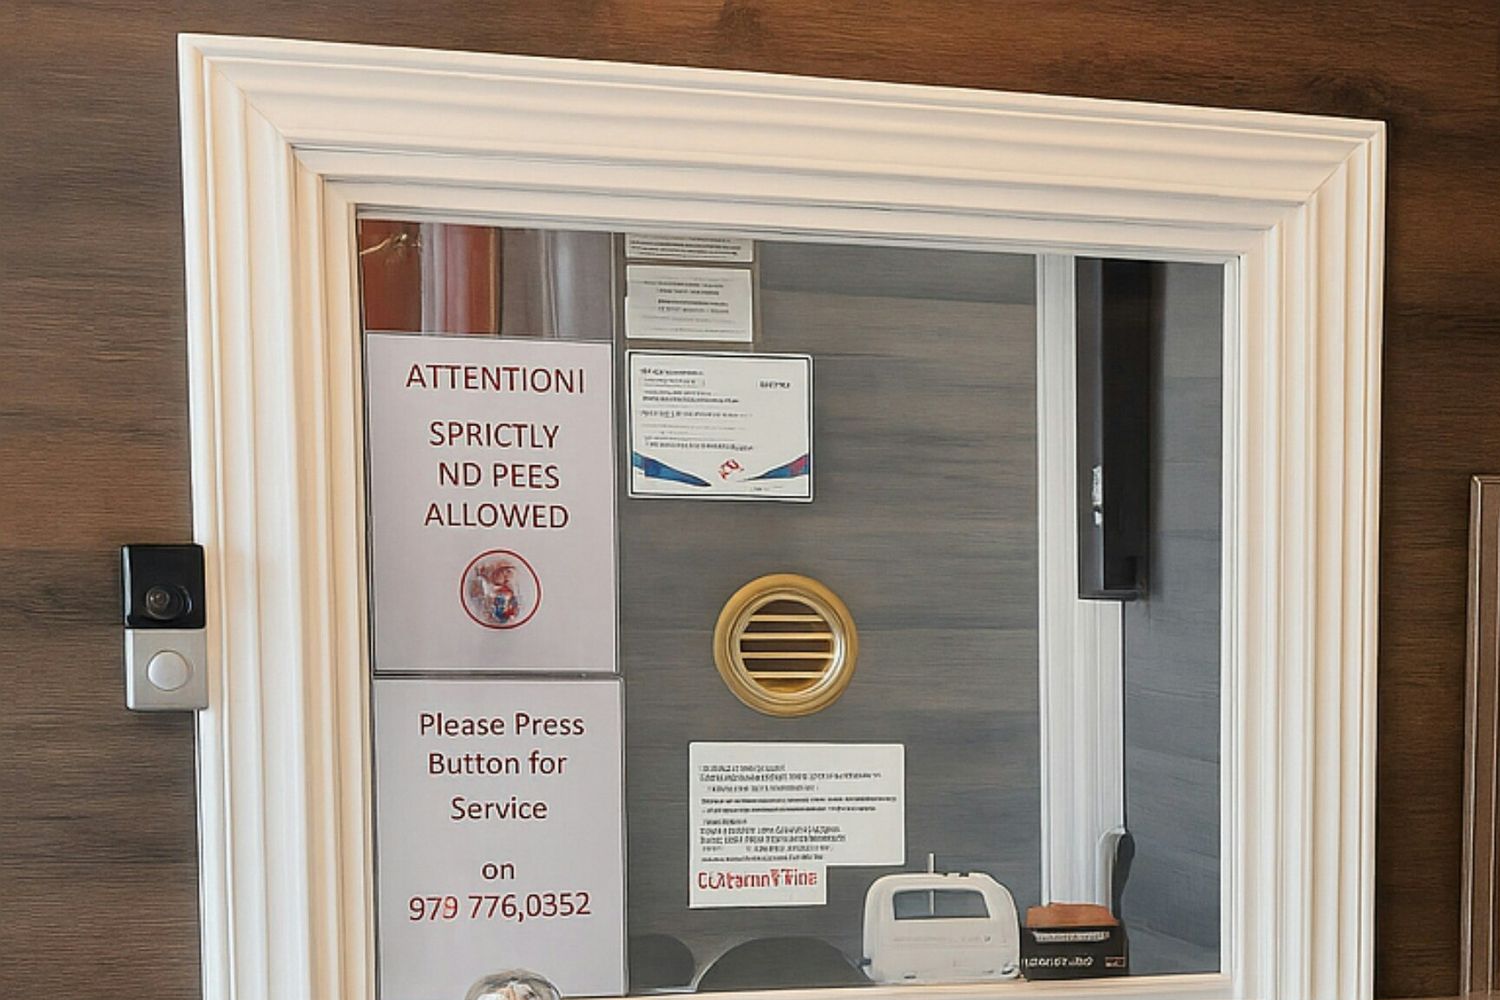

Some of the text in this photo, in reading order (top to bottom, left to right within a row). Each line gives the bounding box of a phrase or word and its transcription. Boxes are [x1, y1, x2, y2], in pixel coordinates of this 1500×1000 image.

[429, 421, 560, 449] SPRICTLY
[438, 462, 560, 490] ND PEES
[424, 503, 569, 529] ALLOWED
[420, 713, 585, 737] Please Press
[428, 750, 568, 775] Button for
[451, 796, 548, 821] Service
[482, 862, 515, 880] on
[409, 896, 458, 921] 979
